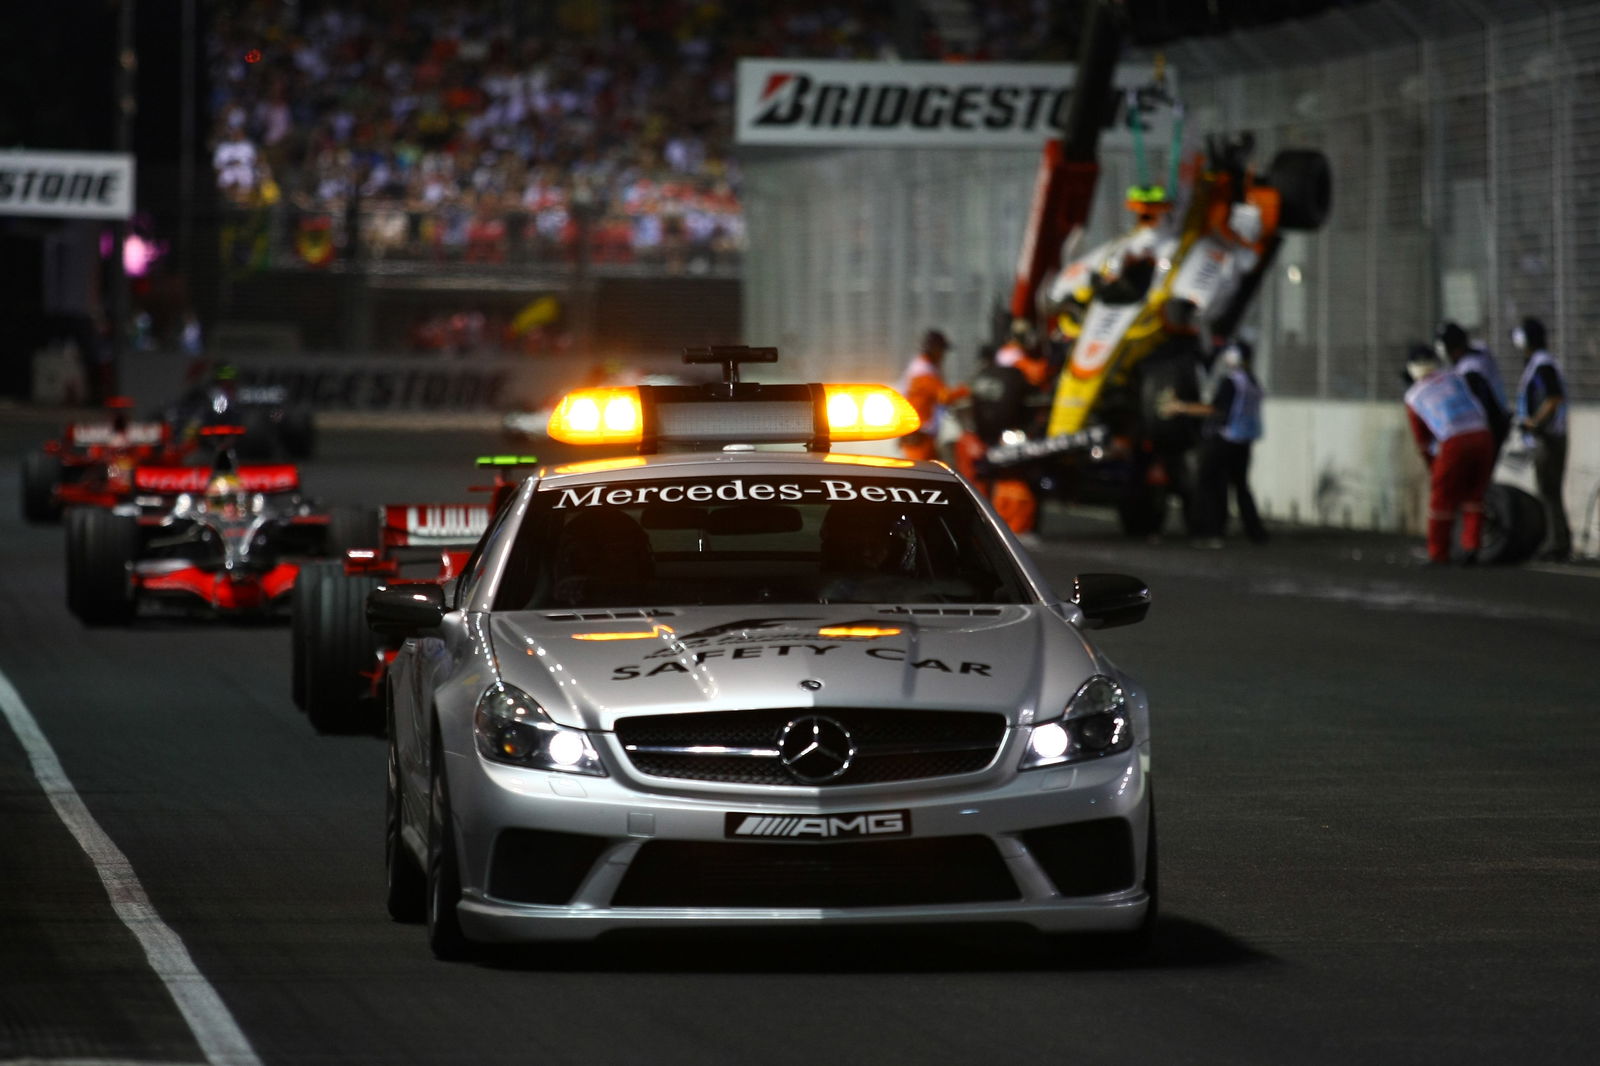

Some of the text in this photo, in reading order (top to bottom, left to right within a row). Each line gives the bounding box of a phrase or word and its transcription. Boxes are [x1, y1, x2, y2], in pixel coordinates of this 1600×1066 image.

[757, 73, 1157, 131] BRIDGESTOE
[552, 479, 949, 510] Mercedes-Benz
[611, 643, 992, 681] SAFETY CAR
